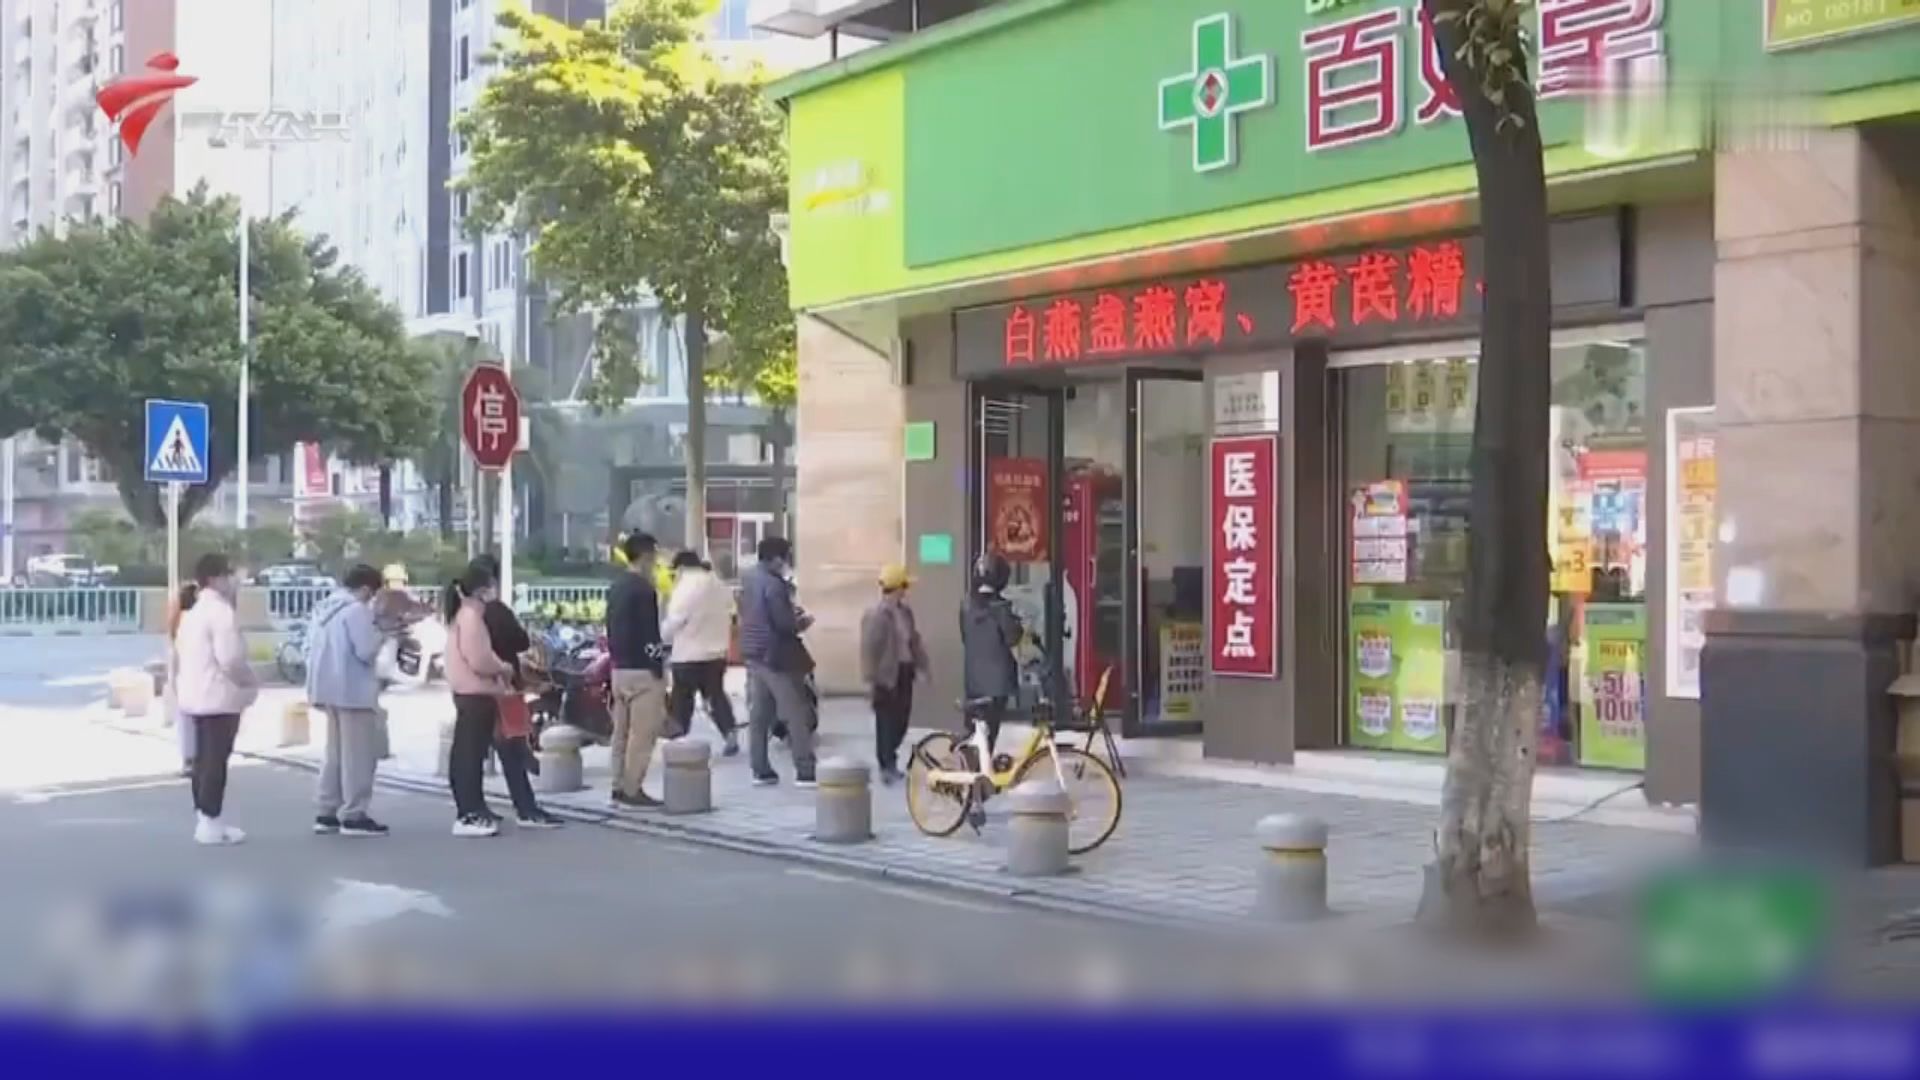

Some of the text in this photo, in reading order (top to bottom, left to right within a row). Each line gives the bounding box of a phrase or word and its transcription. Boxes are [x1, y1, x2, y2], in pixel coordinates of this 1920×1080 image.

[472, 384, 508, 451] 停
[1222, 452, 1257, 658] 医保定点
